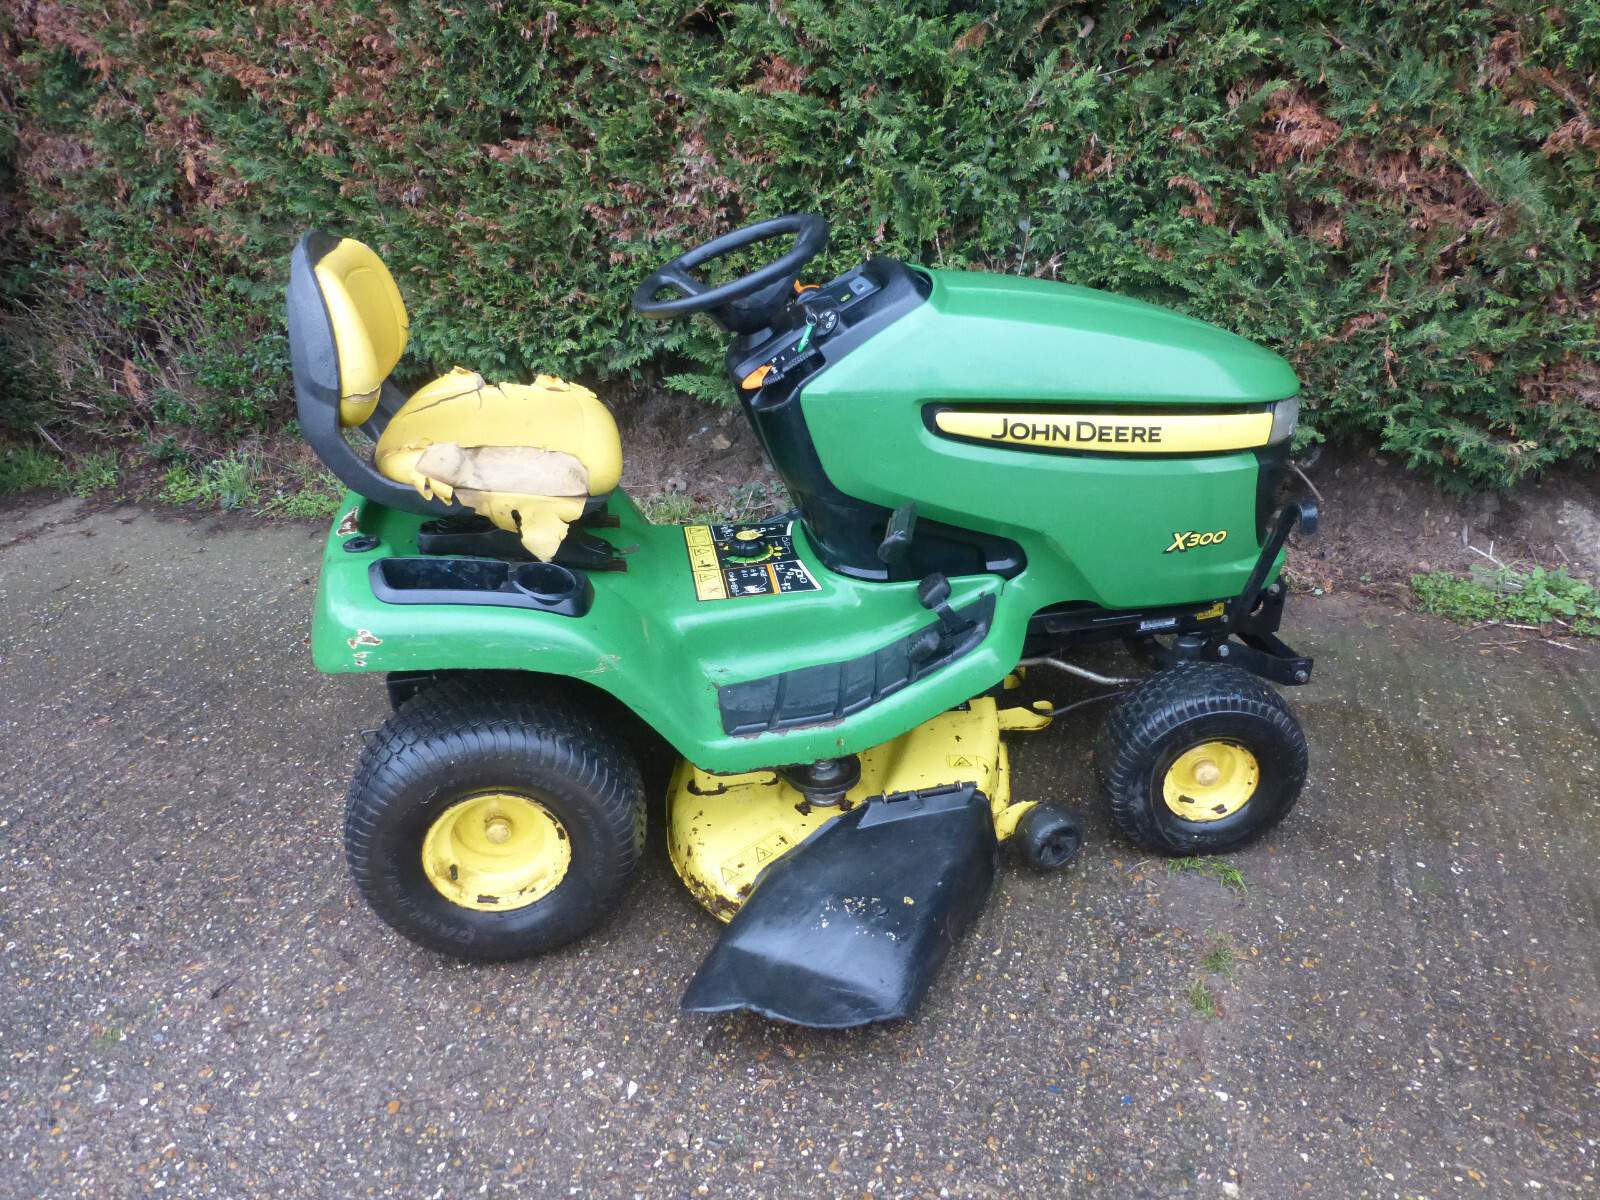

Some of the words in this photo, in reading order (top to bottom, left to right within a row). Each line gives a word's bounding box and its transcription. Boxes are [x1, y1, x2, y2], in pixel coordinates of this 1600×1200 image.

[991, 419, 1070, 441] JOHN
[1076, 422, 1161, 442] DEERE
[1163, 530, 1228, 553] X300
